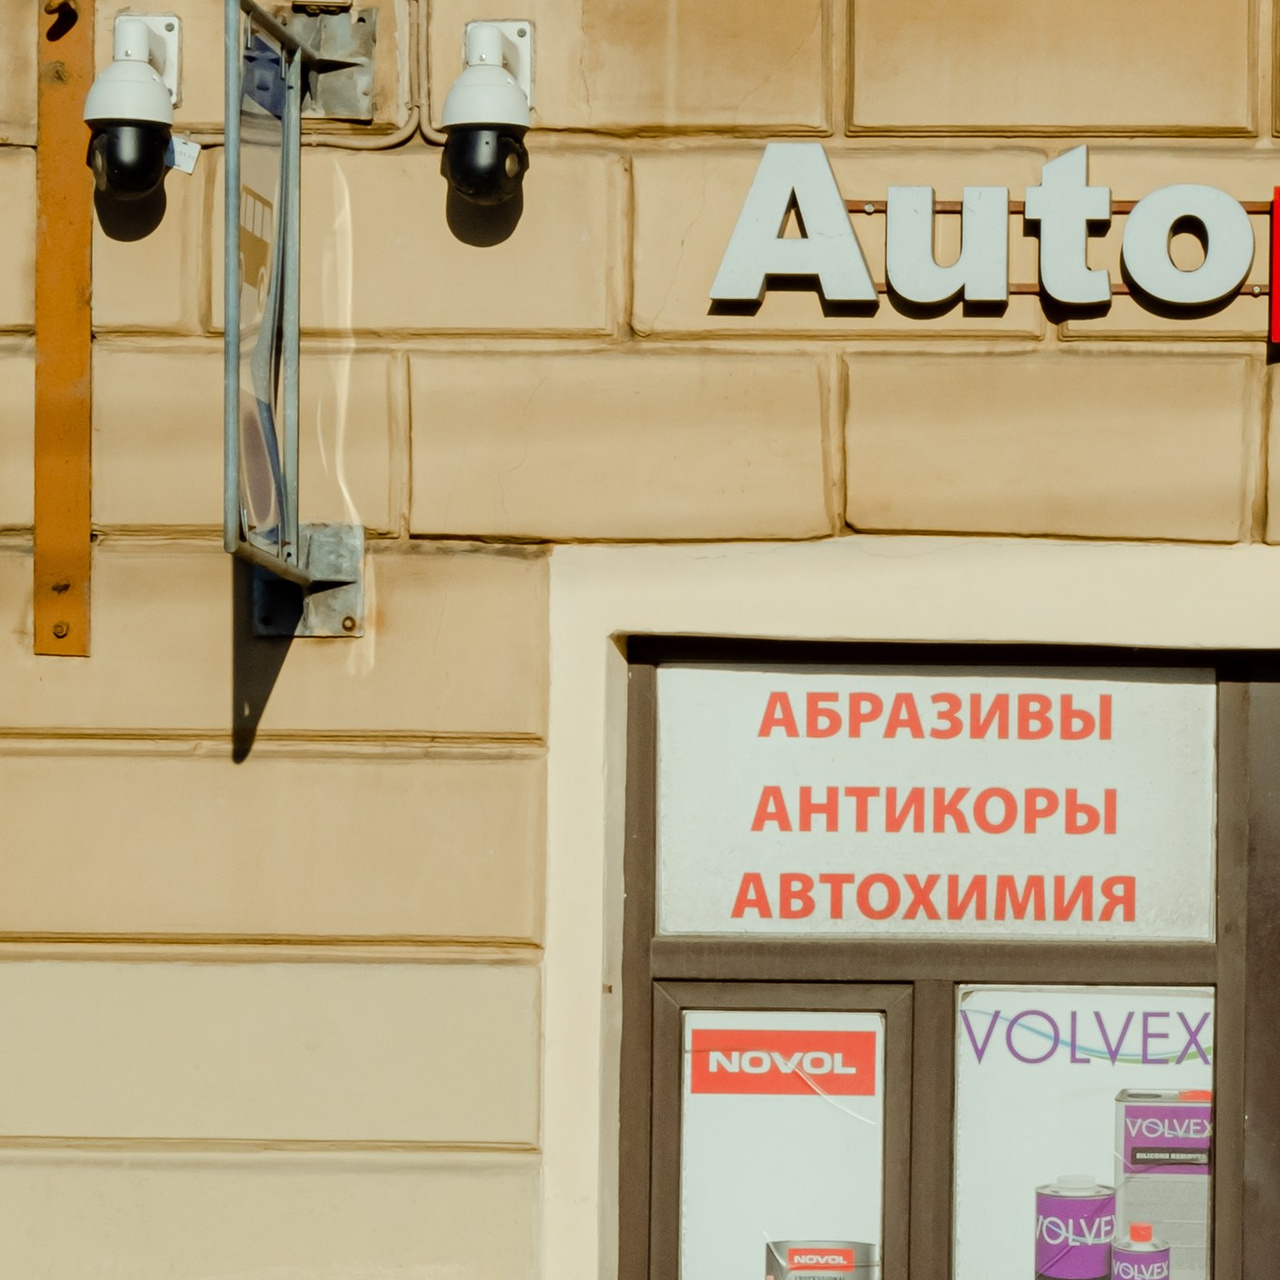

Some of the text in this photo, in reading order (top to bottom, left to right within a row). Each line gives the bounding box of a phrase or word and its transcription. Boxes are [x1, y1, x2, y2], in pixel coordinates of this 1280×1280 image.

[758, 691, 1114, 741] АБРАЗИВЫ
[751, 786, 1118, 835] АНТИКОРЫ
[731, 872, 1137, 923] АВТОХИМИЯ
[960, 1009, 1211, 1066] VOLVEX
[708, 1051, 857, 1075] NOVOL
[1125, 1118, 1213, 1138] VOLVEX
[793, 1253, 848, 1265] NOVOL
[1113, 1259, 1169, 1280] VOLVEX
